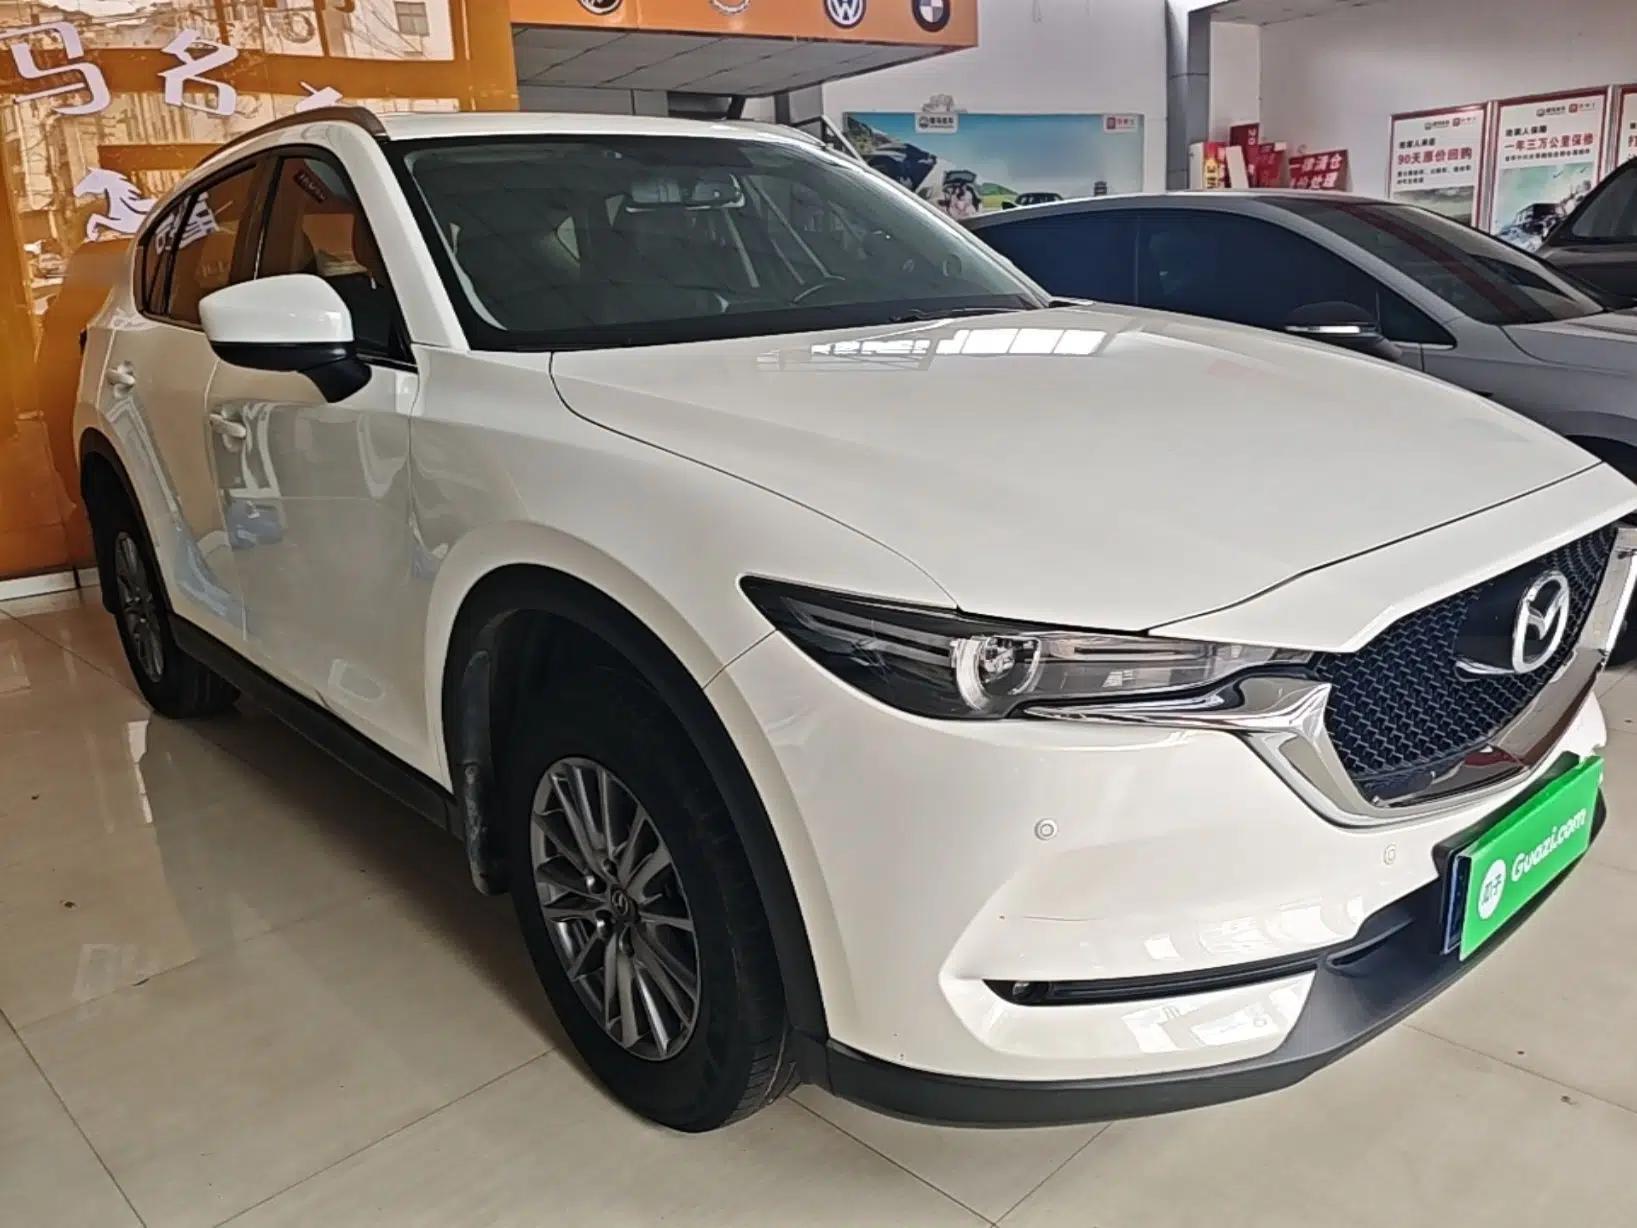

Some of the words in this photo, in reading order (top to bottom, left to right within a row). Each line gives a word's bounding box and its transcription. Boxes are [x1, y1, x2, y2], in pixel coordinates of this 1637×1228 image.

[1504, 133, 1594, 151] 一年三万公里保修
[1398, 147, 1472, 165] 90天原价回购
[1512, 808, 1587, 882] Guazi.com
